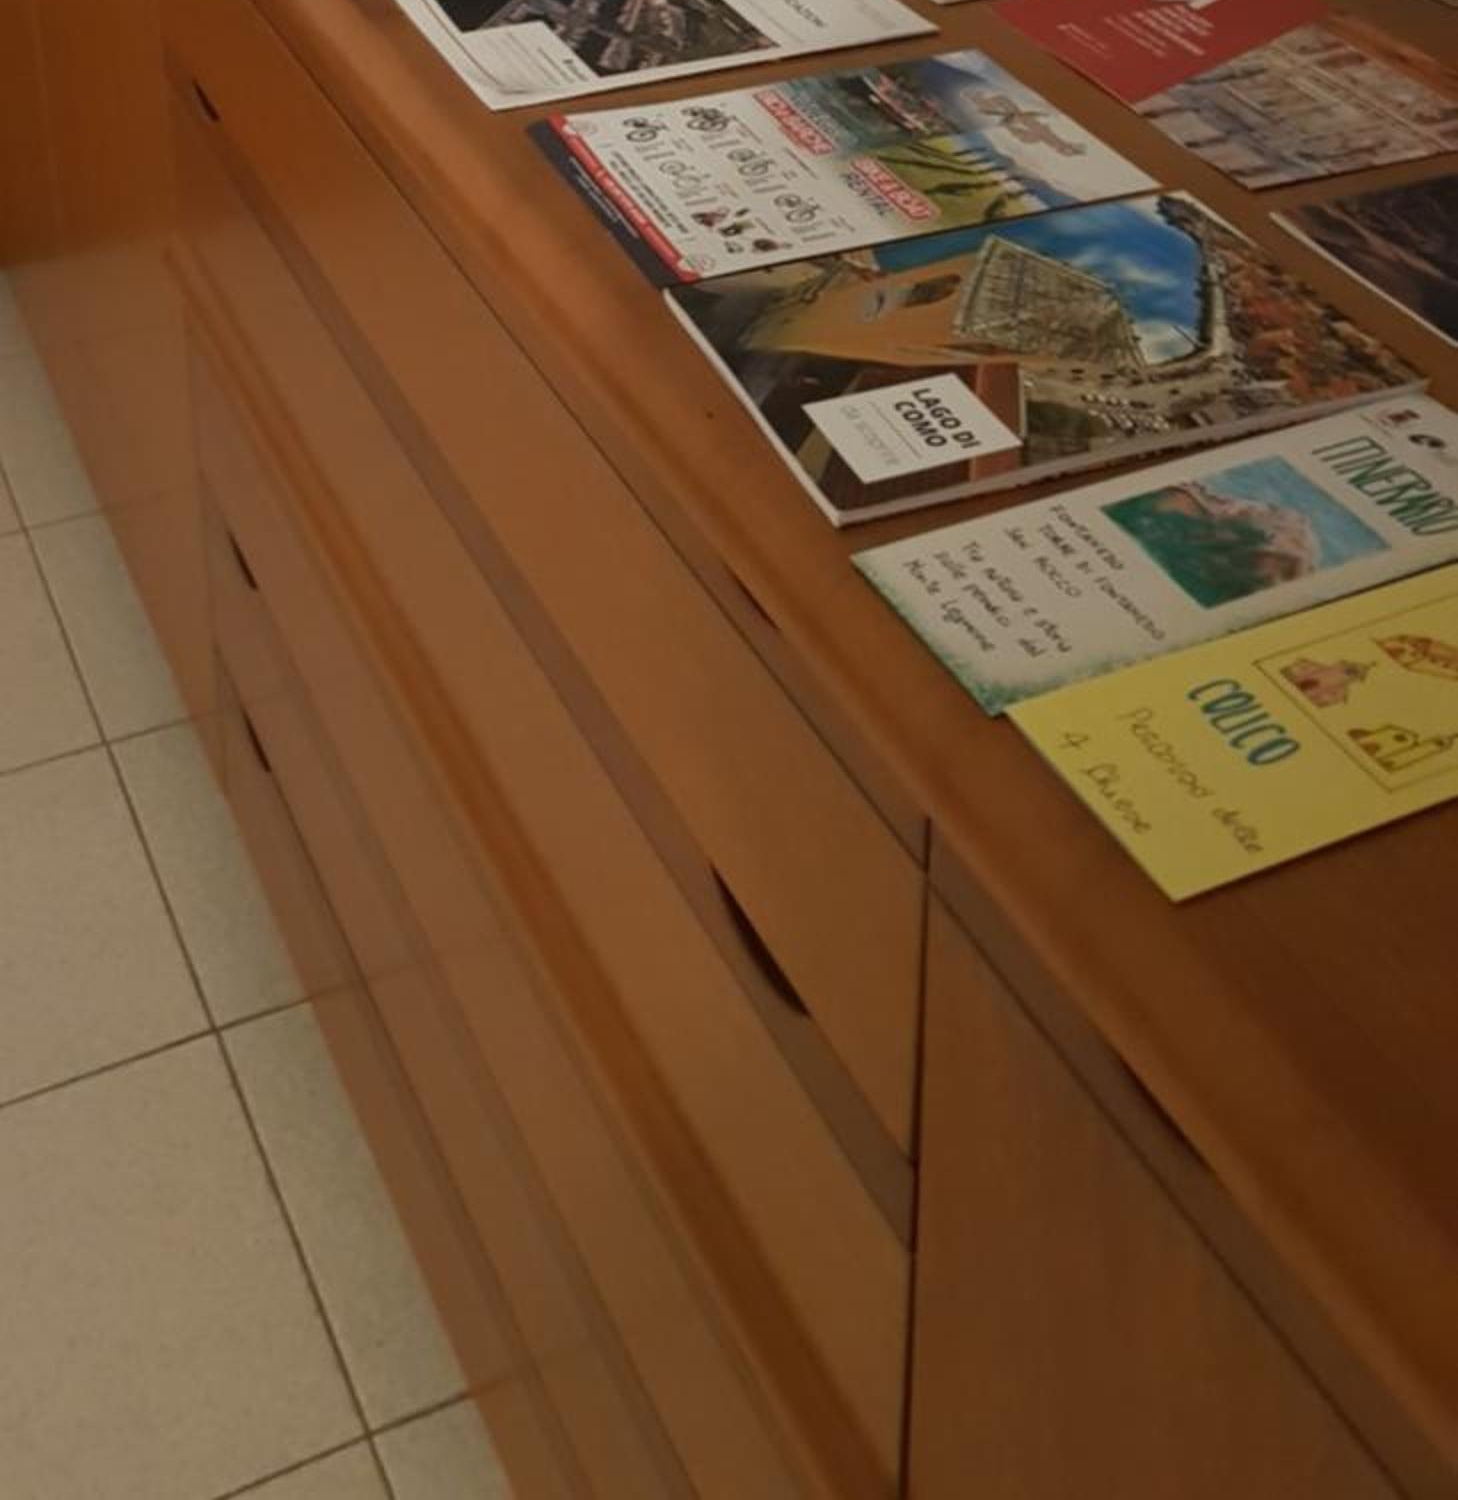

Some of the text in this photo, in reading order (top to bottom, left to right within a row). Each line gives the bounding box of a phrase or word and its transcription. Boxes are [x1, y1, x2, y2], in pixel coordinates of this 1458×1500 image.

[895, 401, 948, 447] COMO
[912, 388, 982, 449] LAGO DI
[1032, 555, 1083, 598] ROCCO
[1059, 731, 1090, 750] 4
[1186, 677, 1301, 767] COLICO
